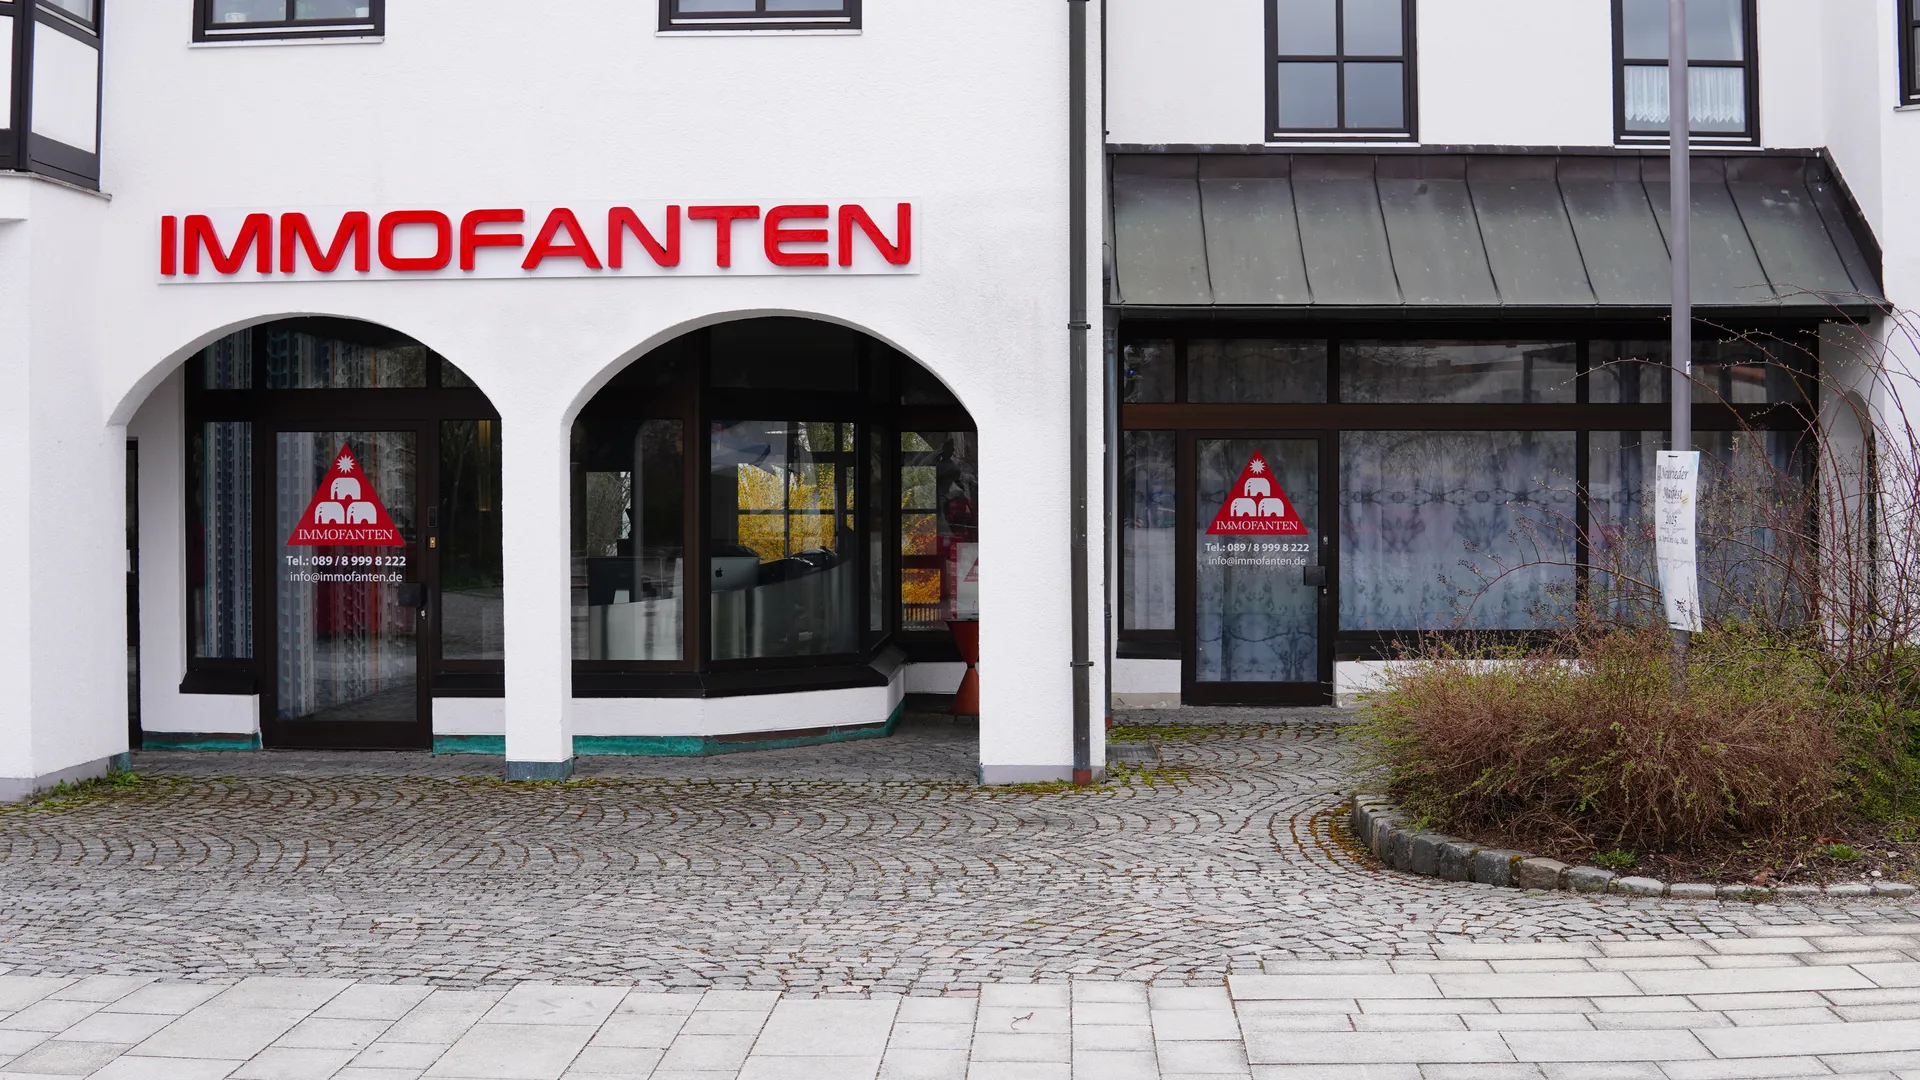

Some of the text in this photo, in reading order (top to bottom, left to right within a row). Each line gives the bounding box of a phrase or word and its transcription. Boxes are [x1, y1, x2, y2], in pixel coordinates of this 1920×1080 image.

[160, 202, 912, 276] IMMOFANTEN
[1216, 520, 1298, 530] IMMOFANTEN
[298, 529, 394, 540] IMMOFANTEN
[1206, 543, 1225, 552] Tel.:
[1227, 543, 1246, 552] 089
[1253, 543, 1260, 552] 8
[1262, 543, 1280, 552] 999
[1282, 543, 1289, 552] 8
[1290, 543, 1310, 552] 222
[286, 556, 309, 566] Tel.:
[311, 556, 333, 566] 089
[341, 556, 349, 566] 8
[350, 556, 373, 566] 999
[374, 556, 382, 566] 8
[384, 556, 407, 566] 222
[1208, 556, 1306, 566] info@immofanten.de
[289, 571, 403, 583] info@immofanten.de
